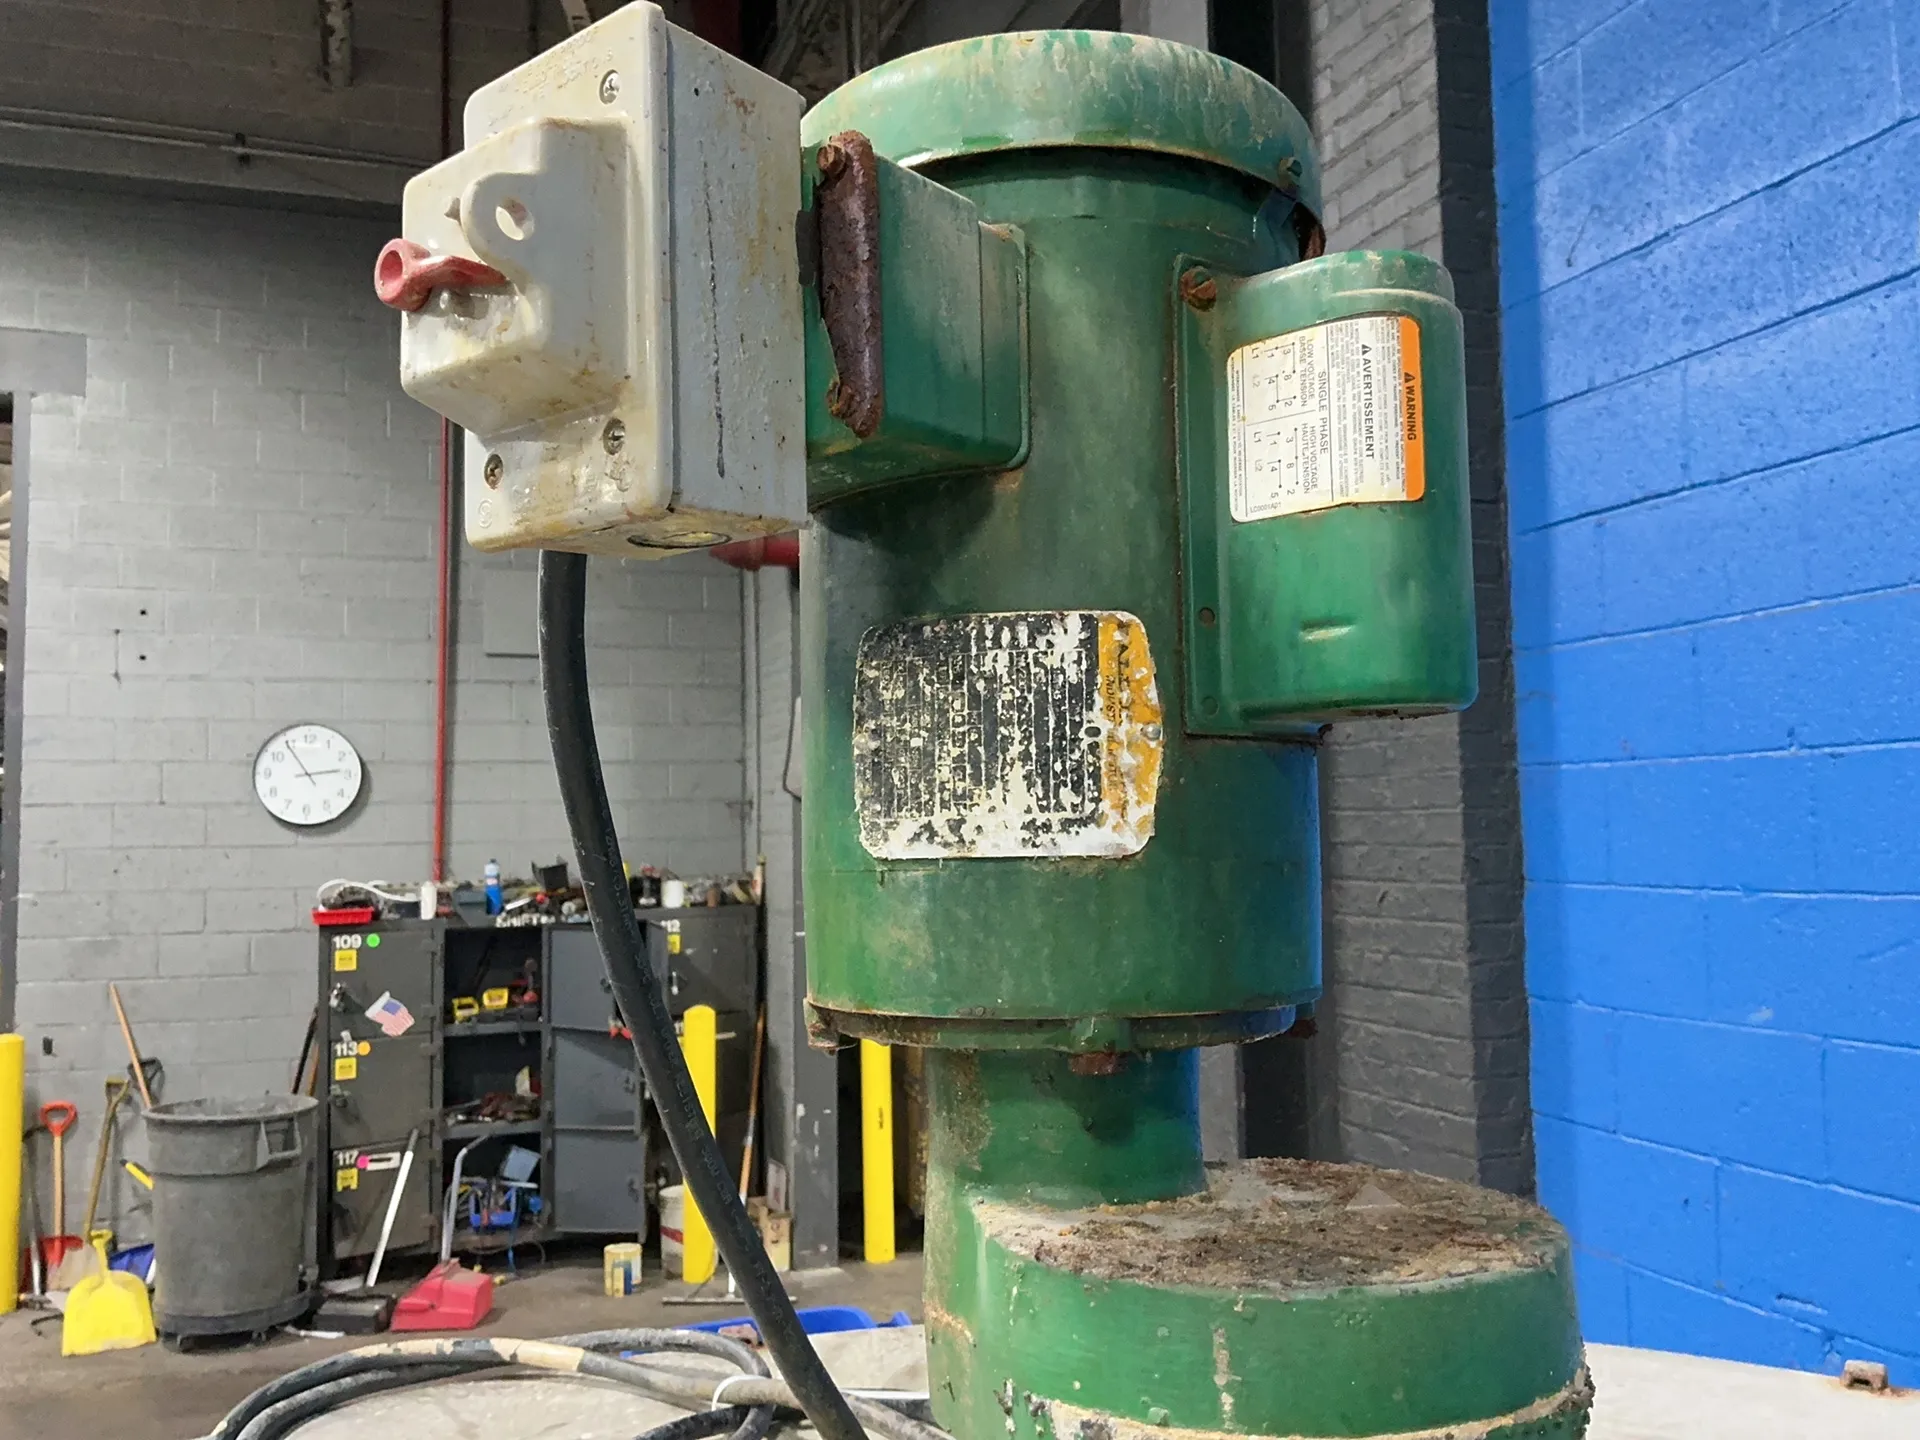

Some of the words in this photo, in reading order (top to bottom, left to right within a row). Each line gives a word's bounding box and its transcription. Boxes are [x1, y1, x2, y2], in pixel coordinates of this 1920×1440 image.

[1318, 372, 1327, 412] SINGLE
[1363, 358, 1374, 459] AVERTISSEMENT
[1406, 386, 1416, 440] WARNING
[1254, 431, 1262, 443] L1
[1320, 417, 1328, 454] PHASE
[1310, 450, 1318, 490] VOLTAGE
[332, 934, 362, 949] 109
[335, 1041, 358, 1056] 113
[337, 1150, 359, 1166] 117
